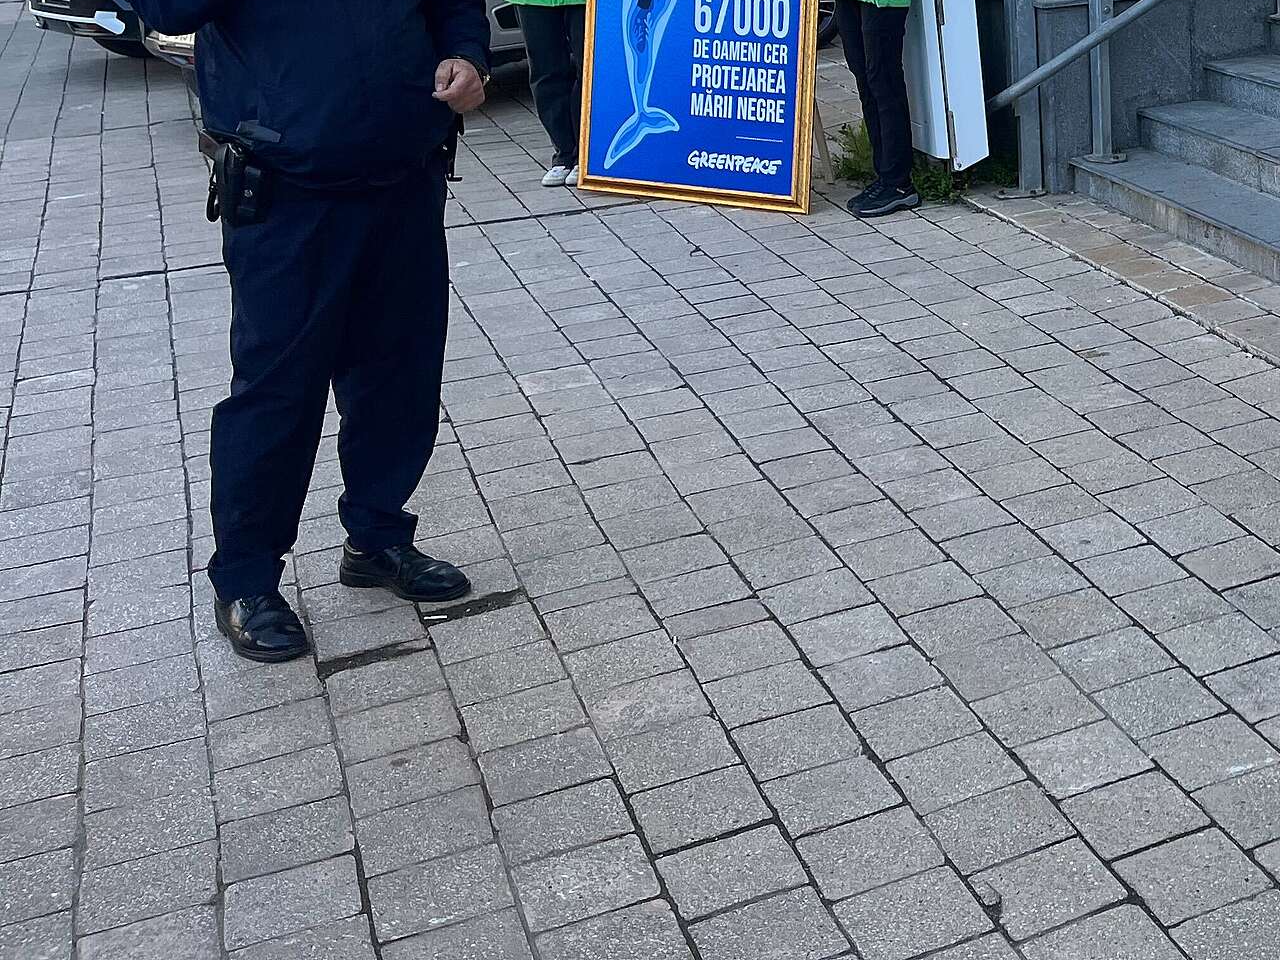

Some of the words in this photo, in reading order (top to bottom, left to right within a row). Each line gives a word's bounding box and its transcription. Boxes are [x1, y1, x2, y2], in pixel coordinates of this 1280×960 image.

[693, 38, 710, 58] DE
[712, 39, 761, 63] OAMENI
[763, 43, 788, 65] CER
[691, 63, 786, 94] PROTEJAREA
[690, 89, 733, 119] MĂRII
[737, 96, 785, 124] NEGRE
[687, 150, 783, 175] GREENPEACE
